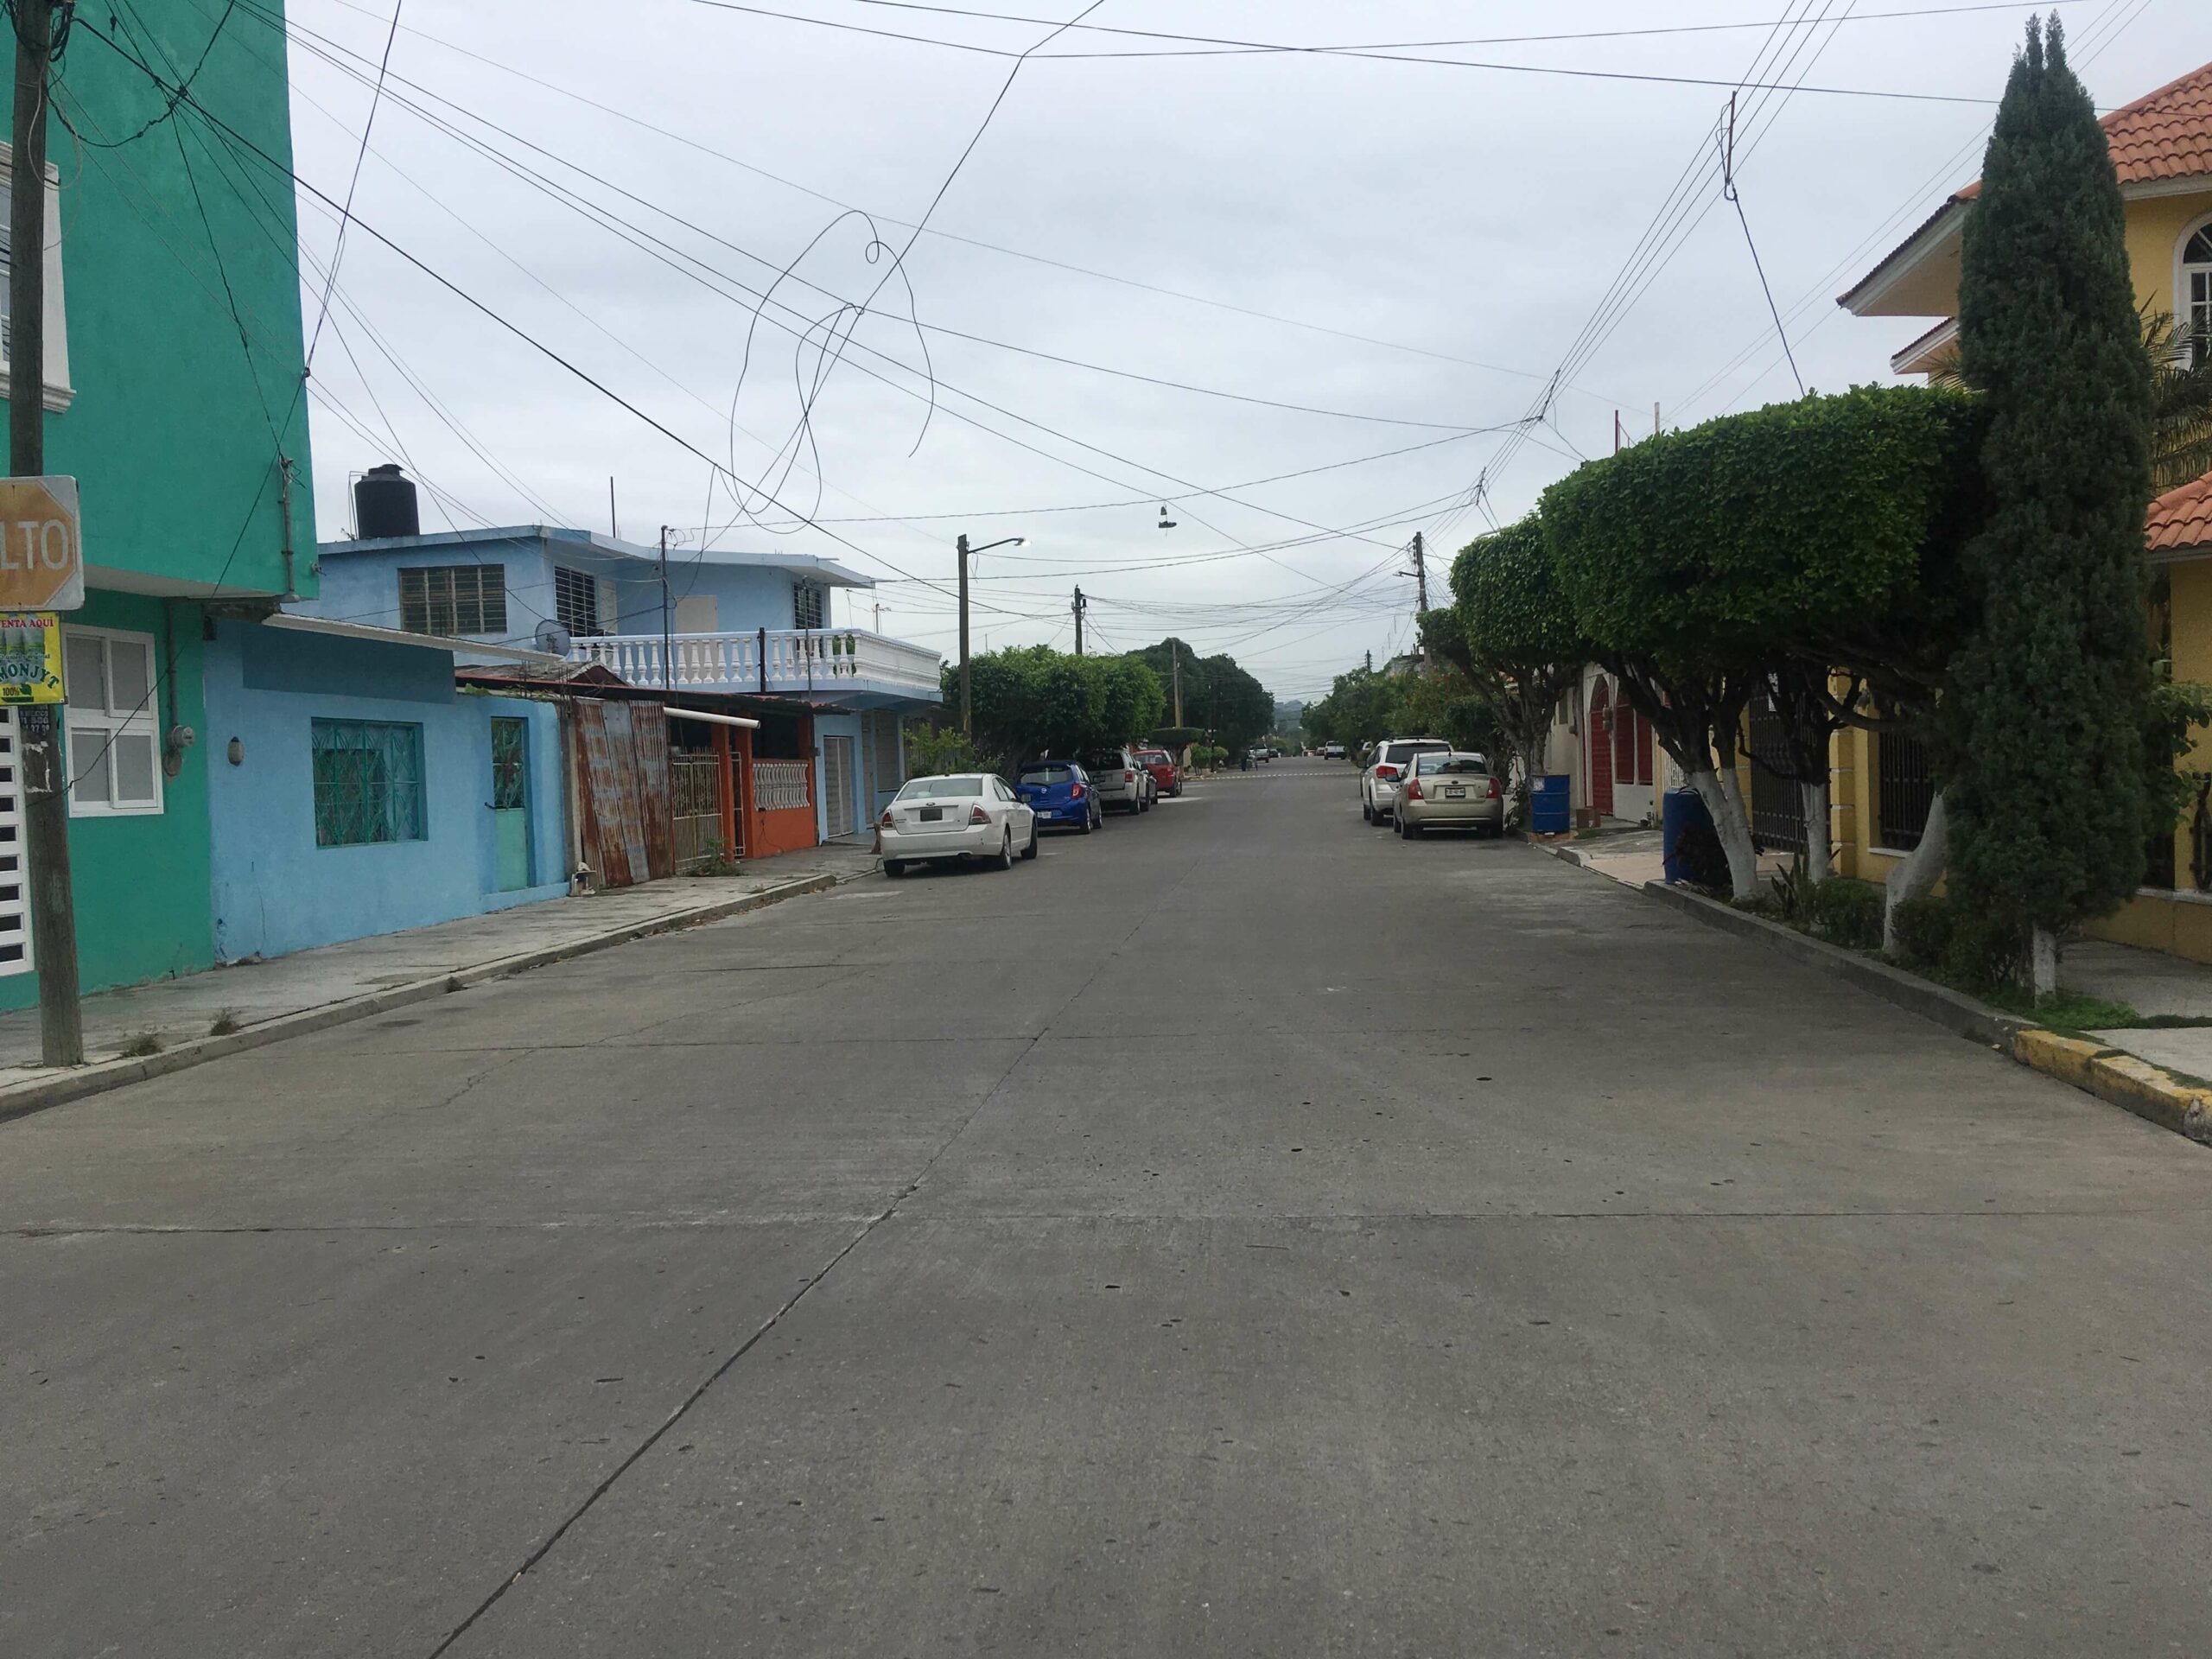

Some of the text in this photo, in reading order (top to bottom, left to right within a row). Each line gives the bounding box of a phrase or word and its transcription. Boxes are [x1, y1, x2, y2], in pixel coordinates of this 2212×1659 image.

[0, 519, 69, 571] LTO
[0, 619, 27, 628] ENTA
[3, 686, 20, 696] 100%
